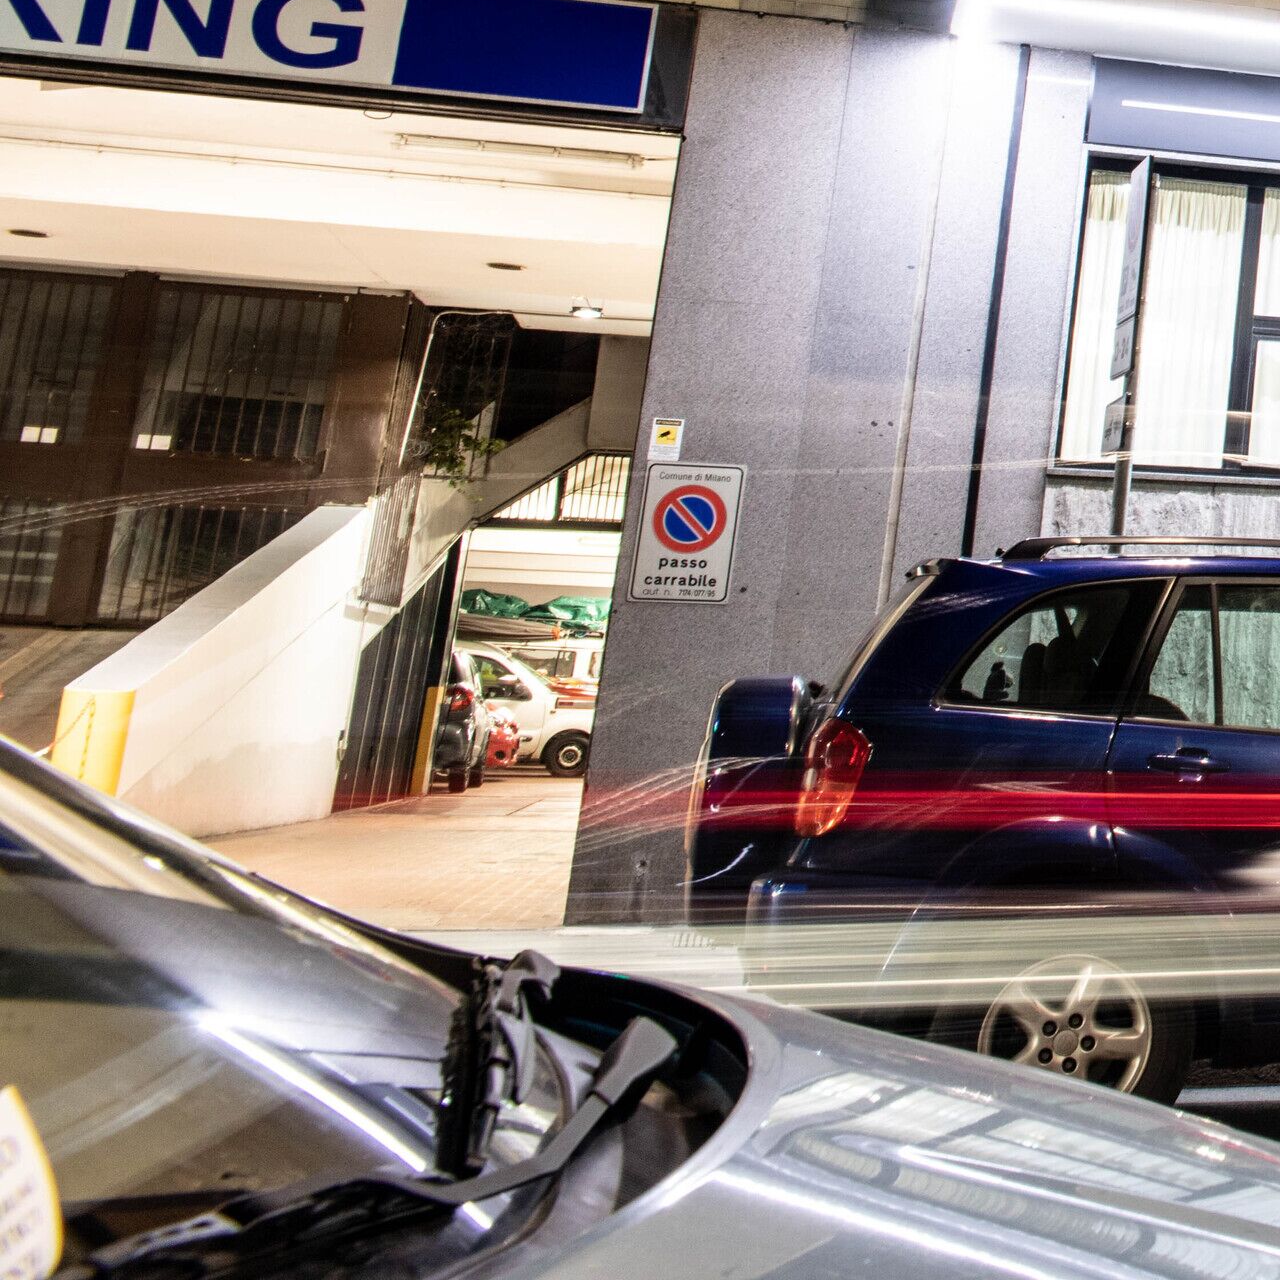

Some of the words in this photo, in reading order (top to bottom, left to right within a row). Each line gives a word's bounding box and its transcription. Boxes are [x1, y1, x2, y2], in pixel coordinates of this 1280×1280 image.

[659, 471, 693, 481] Comune
[694, 472, 703, 481] di
[705, 473, 732, 483] Milano
[658, 557, 708, 570] passo
[644, 573, 718, 588] carrabile
